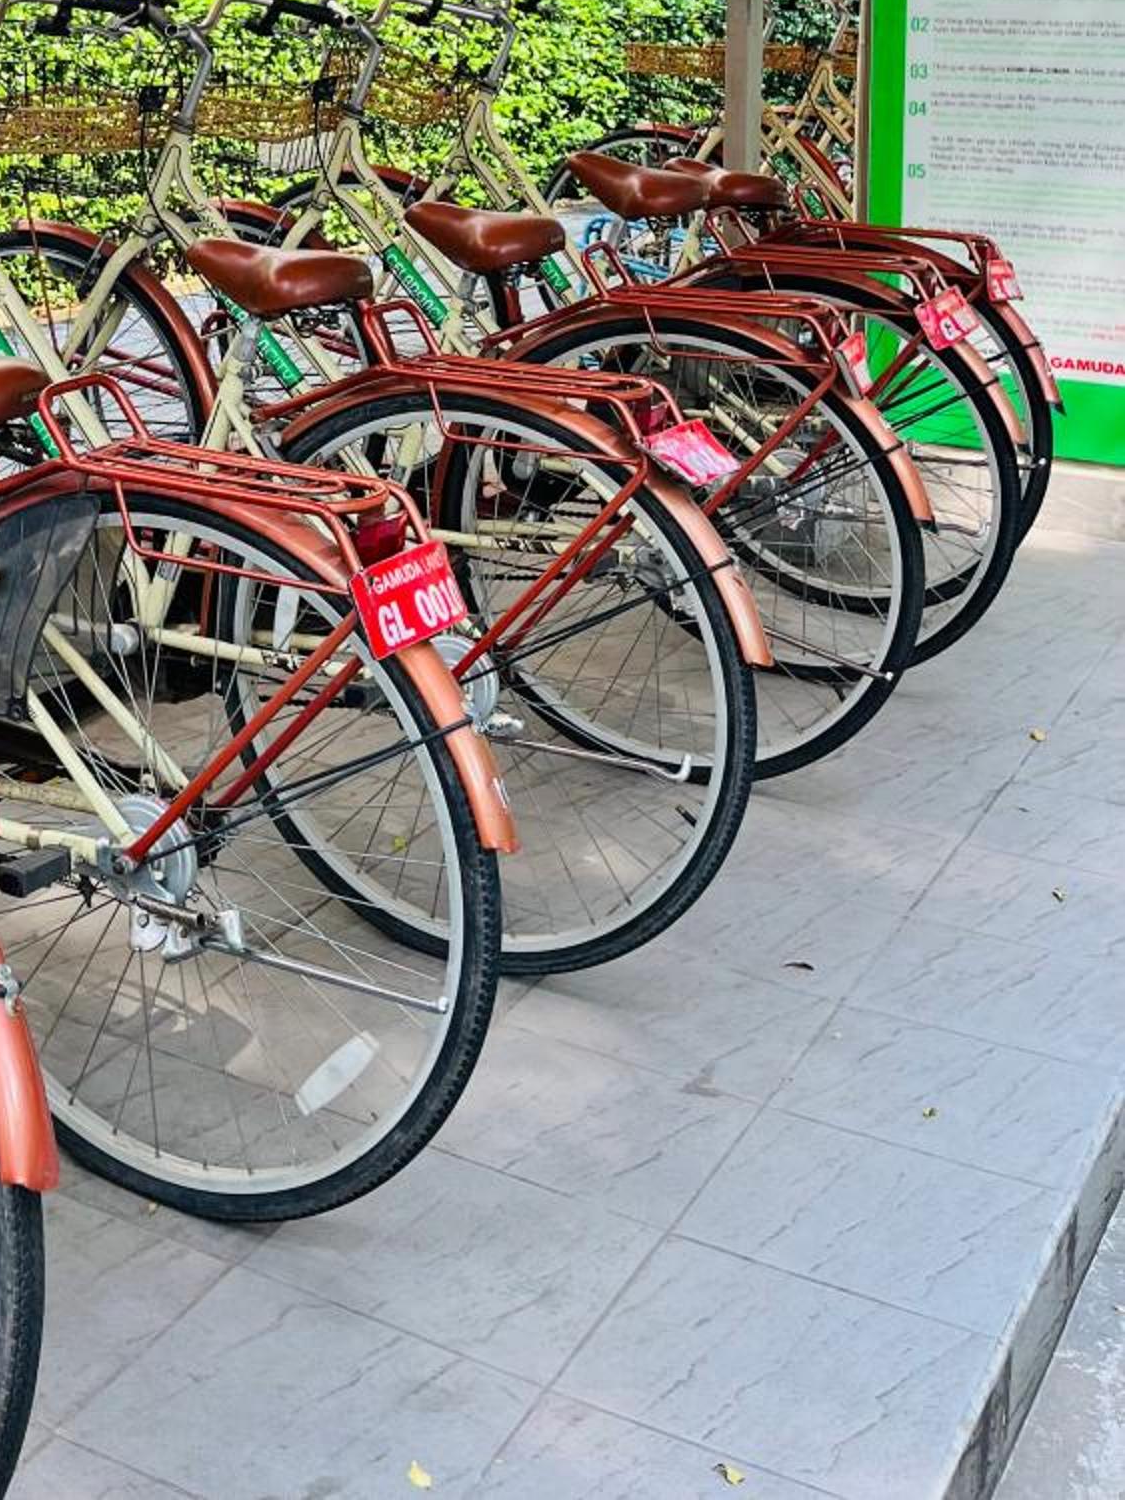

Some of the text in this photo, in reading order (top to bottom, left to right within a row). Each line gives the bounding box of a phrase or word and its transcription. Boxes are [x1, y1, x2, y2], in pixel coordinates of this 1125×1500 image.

[911, 18, 930, 32] 02
[910, 64, 928, 79] 03
[909, 102, 926, 116] 04
[908, 163, 925, 179] 05
[1050, 357, 1125, 376] GAMUDA
[374, 561, 423, 595] GAMUDA
[378, 601, 416, 647] GL
